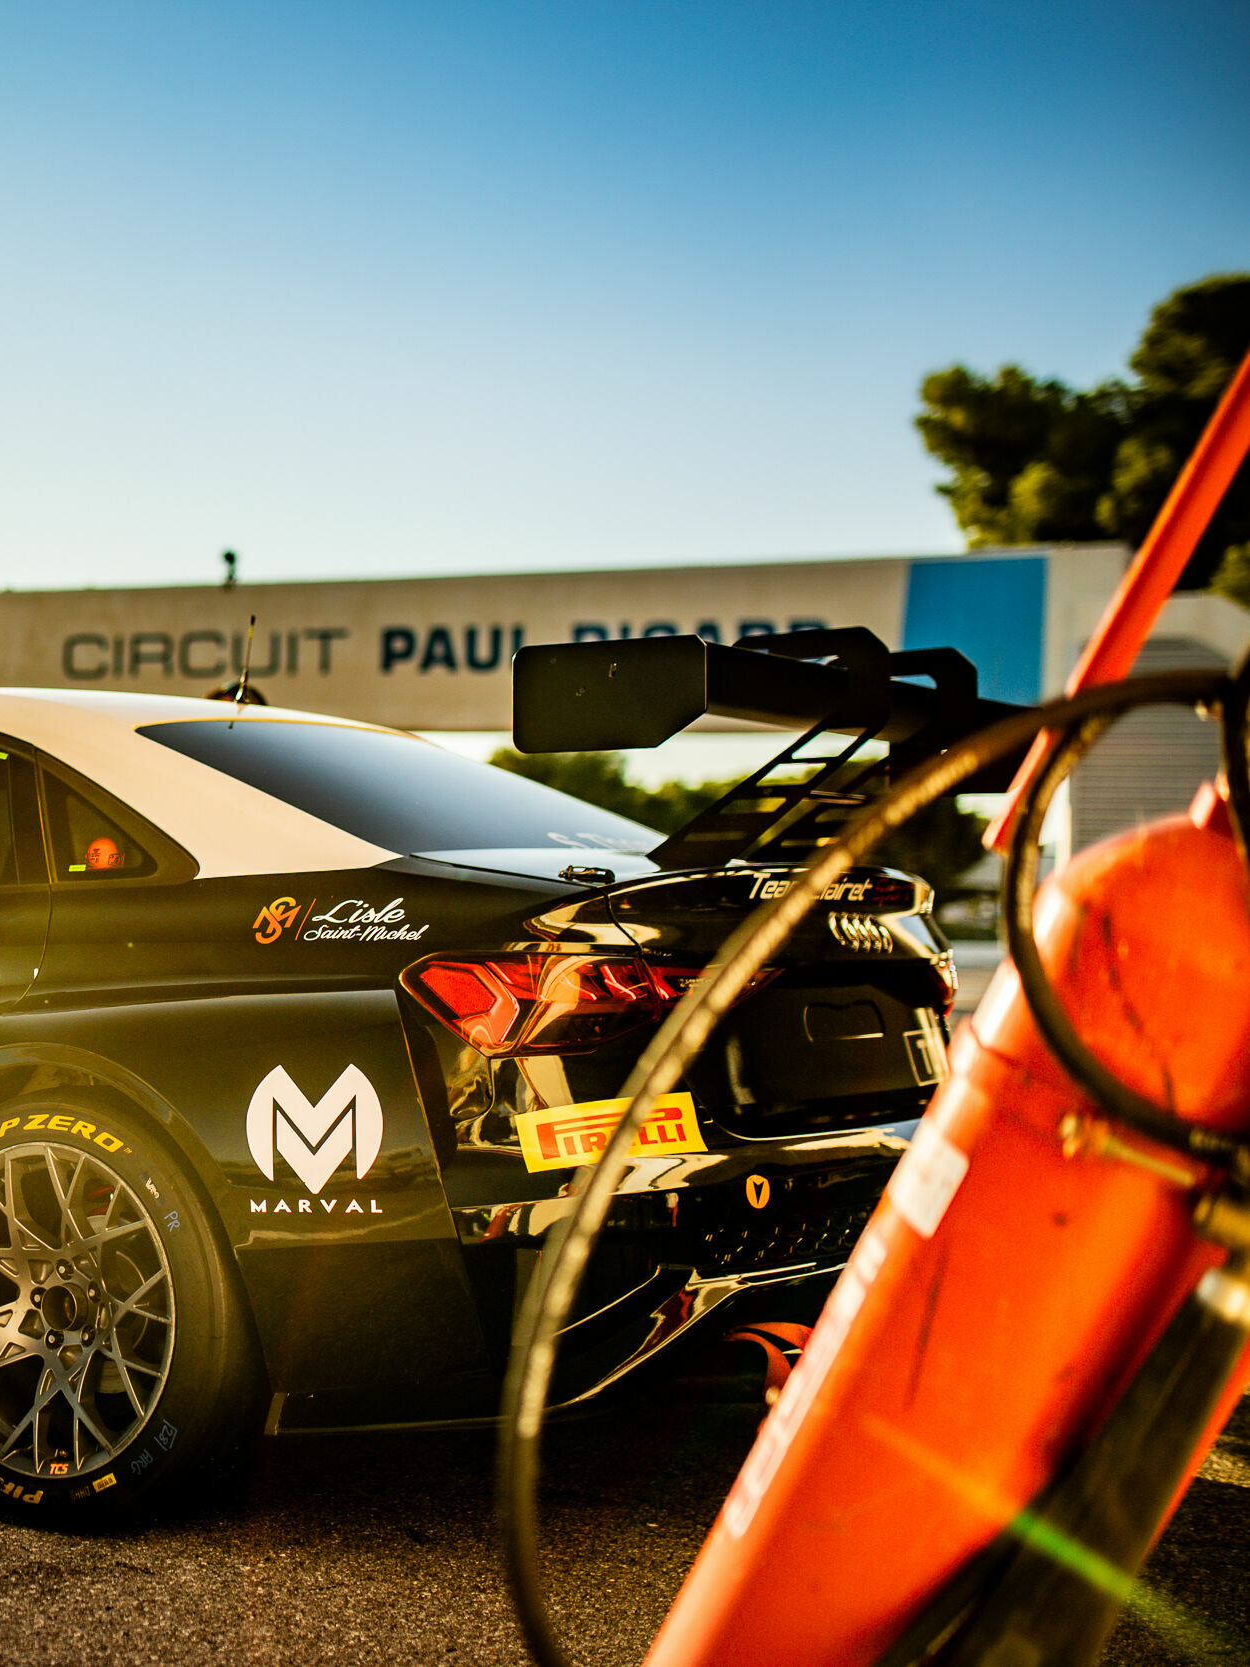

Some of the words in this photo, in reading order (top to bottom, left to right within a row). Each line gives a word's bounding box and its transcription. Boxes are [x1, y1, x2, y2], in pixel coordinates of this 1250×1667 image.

[62, 627, 349, 681] CIRCUIT
[812, 876, 873, 901] lairet
[303, 924, 430, 942] Saint-Michel
[536, 1107, 687, 1160] PIRLLI
[250, 1199, 383, 1214] MARVAL
